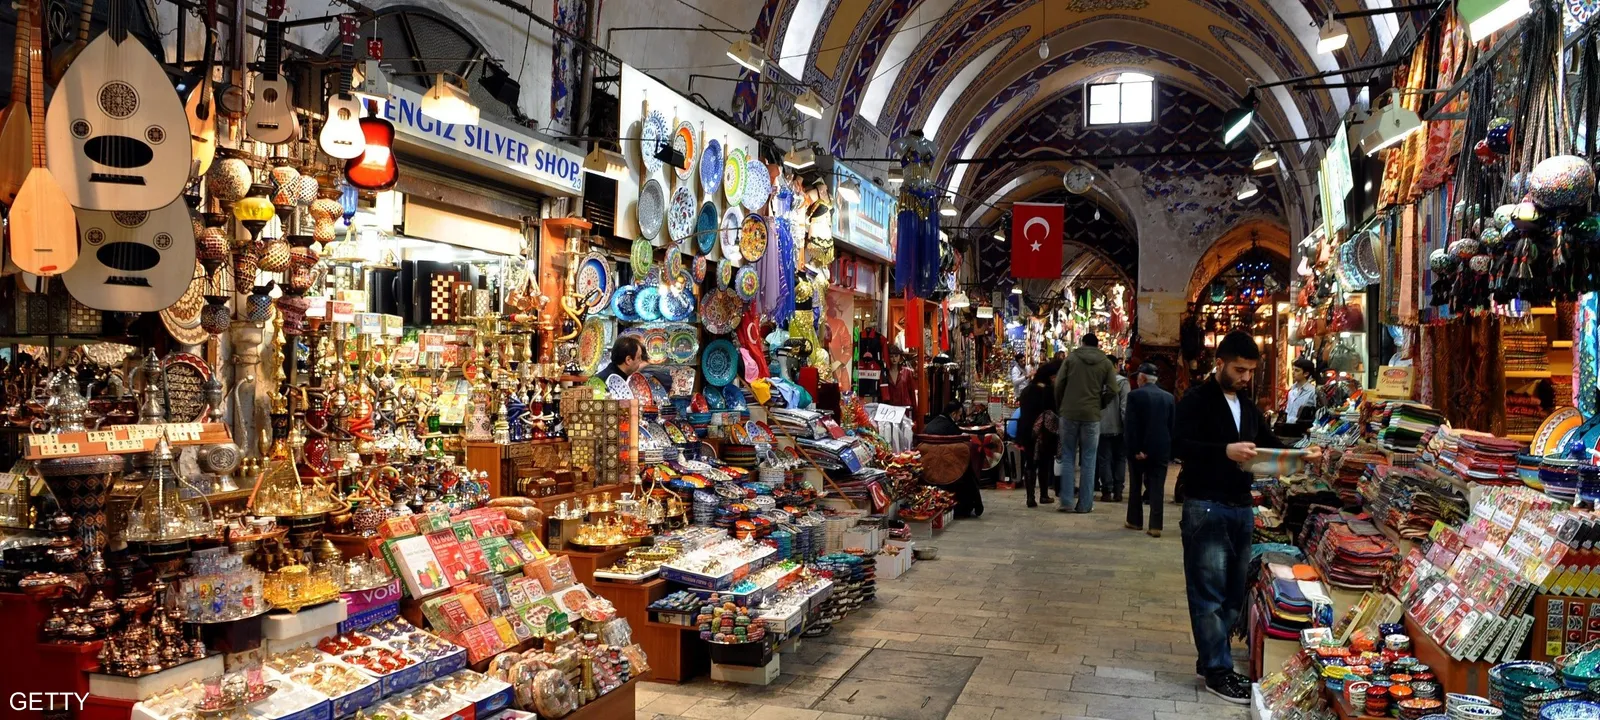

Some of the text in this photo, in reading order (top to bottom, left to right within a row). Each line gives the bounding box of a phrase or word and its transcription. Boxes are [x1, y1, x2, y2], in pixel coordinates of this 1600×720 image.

[363, 96, 580, 182] ENGIZ SILVER SHOP
[572, 177, 582, 189] 23
[880, 407, 896, 421] 40
[381, 546, 394, 566] Turkish
[1472, 619, 1490, 642] APPLE
[1486, 621, 1504, 642] APPLE
[1504, 620, 1518, 643] APPLE
[1519, 619, 1533, 643] APPLE
[1460, 644, 1472, 656] TEA
[1474, 644, 1486, 657] TEA
[1492, 645, 1502, 659] TEA
[1509, 646, 1520, 660] TEA
